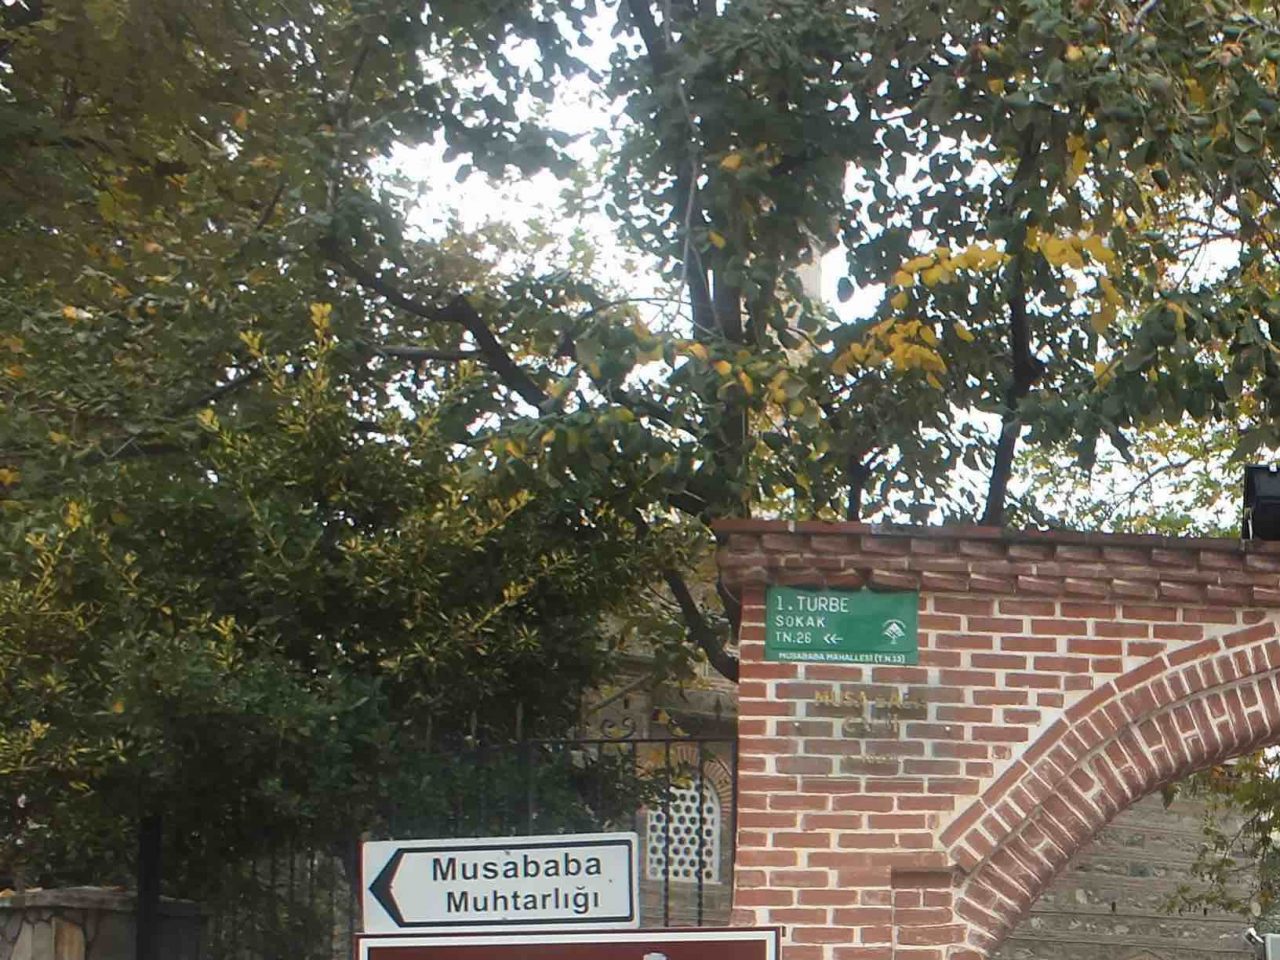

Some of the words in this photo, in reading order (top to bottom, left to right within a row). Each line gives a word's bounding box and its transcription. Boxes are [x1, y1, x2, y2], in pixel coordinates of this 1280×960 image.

[775, 616, 825, 628] SOKAK
[776, 631, 812, 644] TN.26
[432, 853, 602, 883] Musababa
[446, 887, 600, 914] Muhtarlığı
